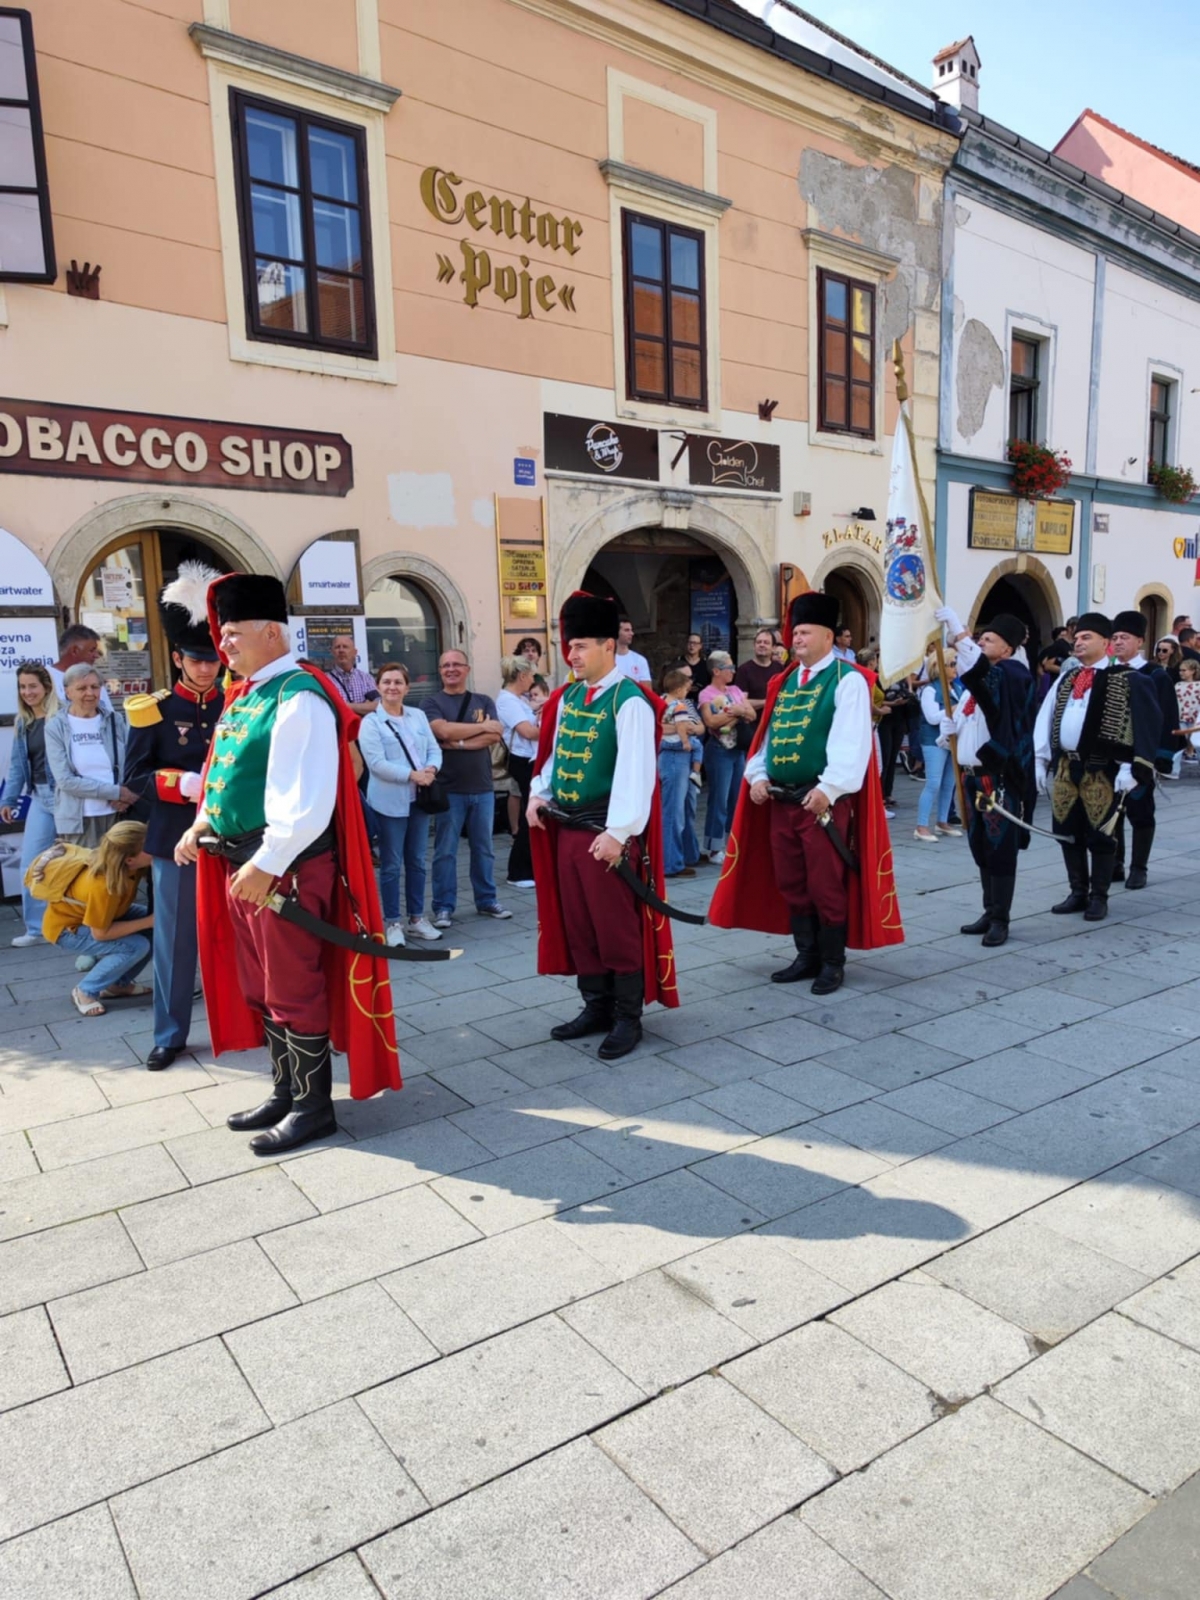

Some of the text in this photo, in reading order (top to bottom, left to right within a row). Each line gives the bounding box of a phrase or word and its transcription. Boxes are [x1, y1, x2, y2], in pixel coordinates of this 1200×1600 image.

[420, 166, 583, 256] Centar
[220, 435, 342, 482] SHOP
[746, 475, 765, 487] Chef
